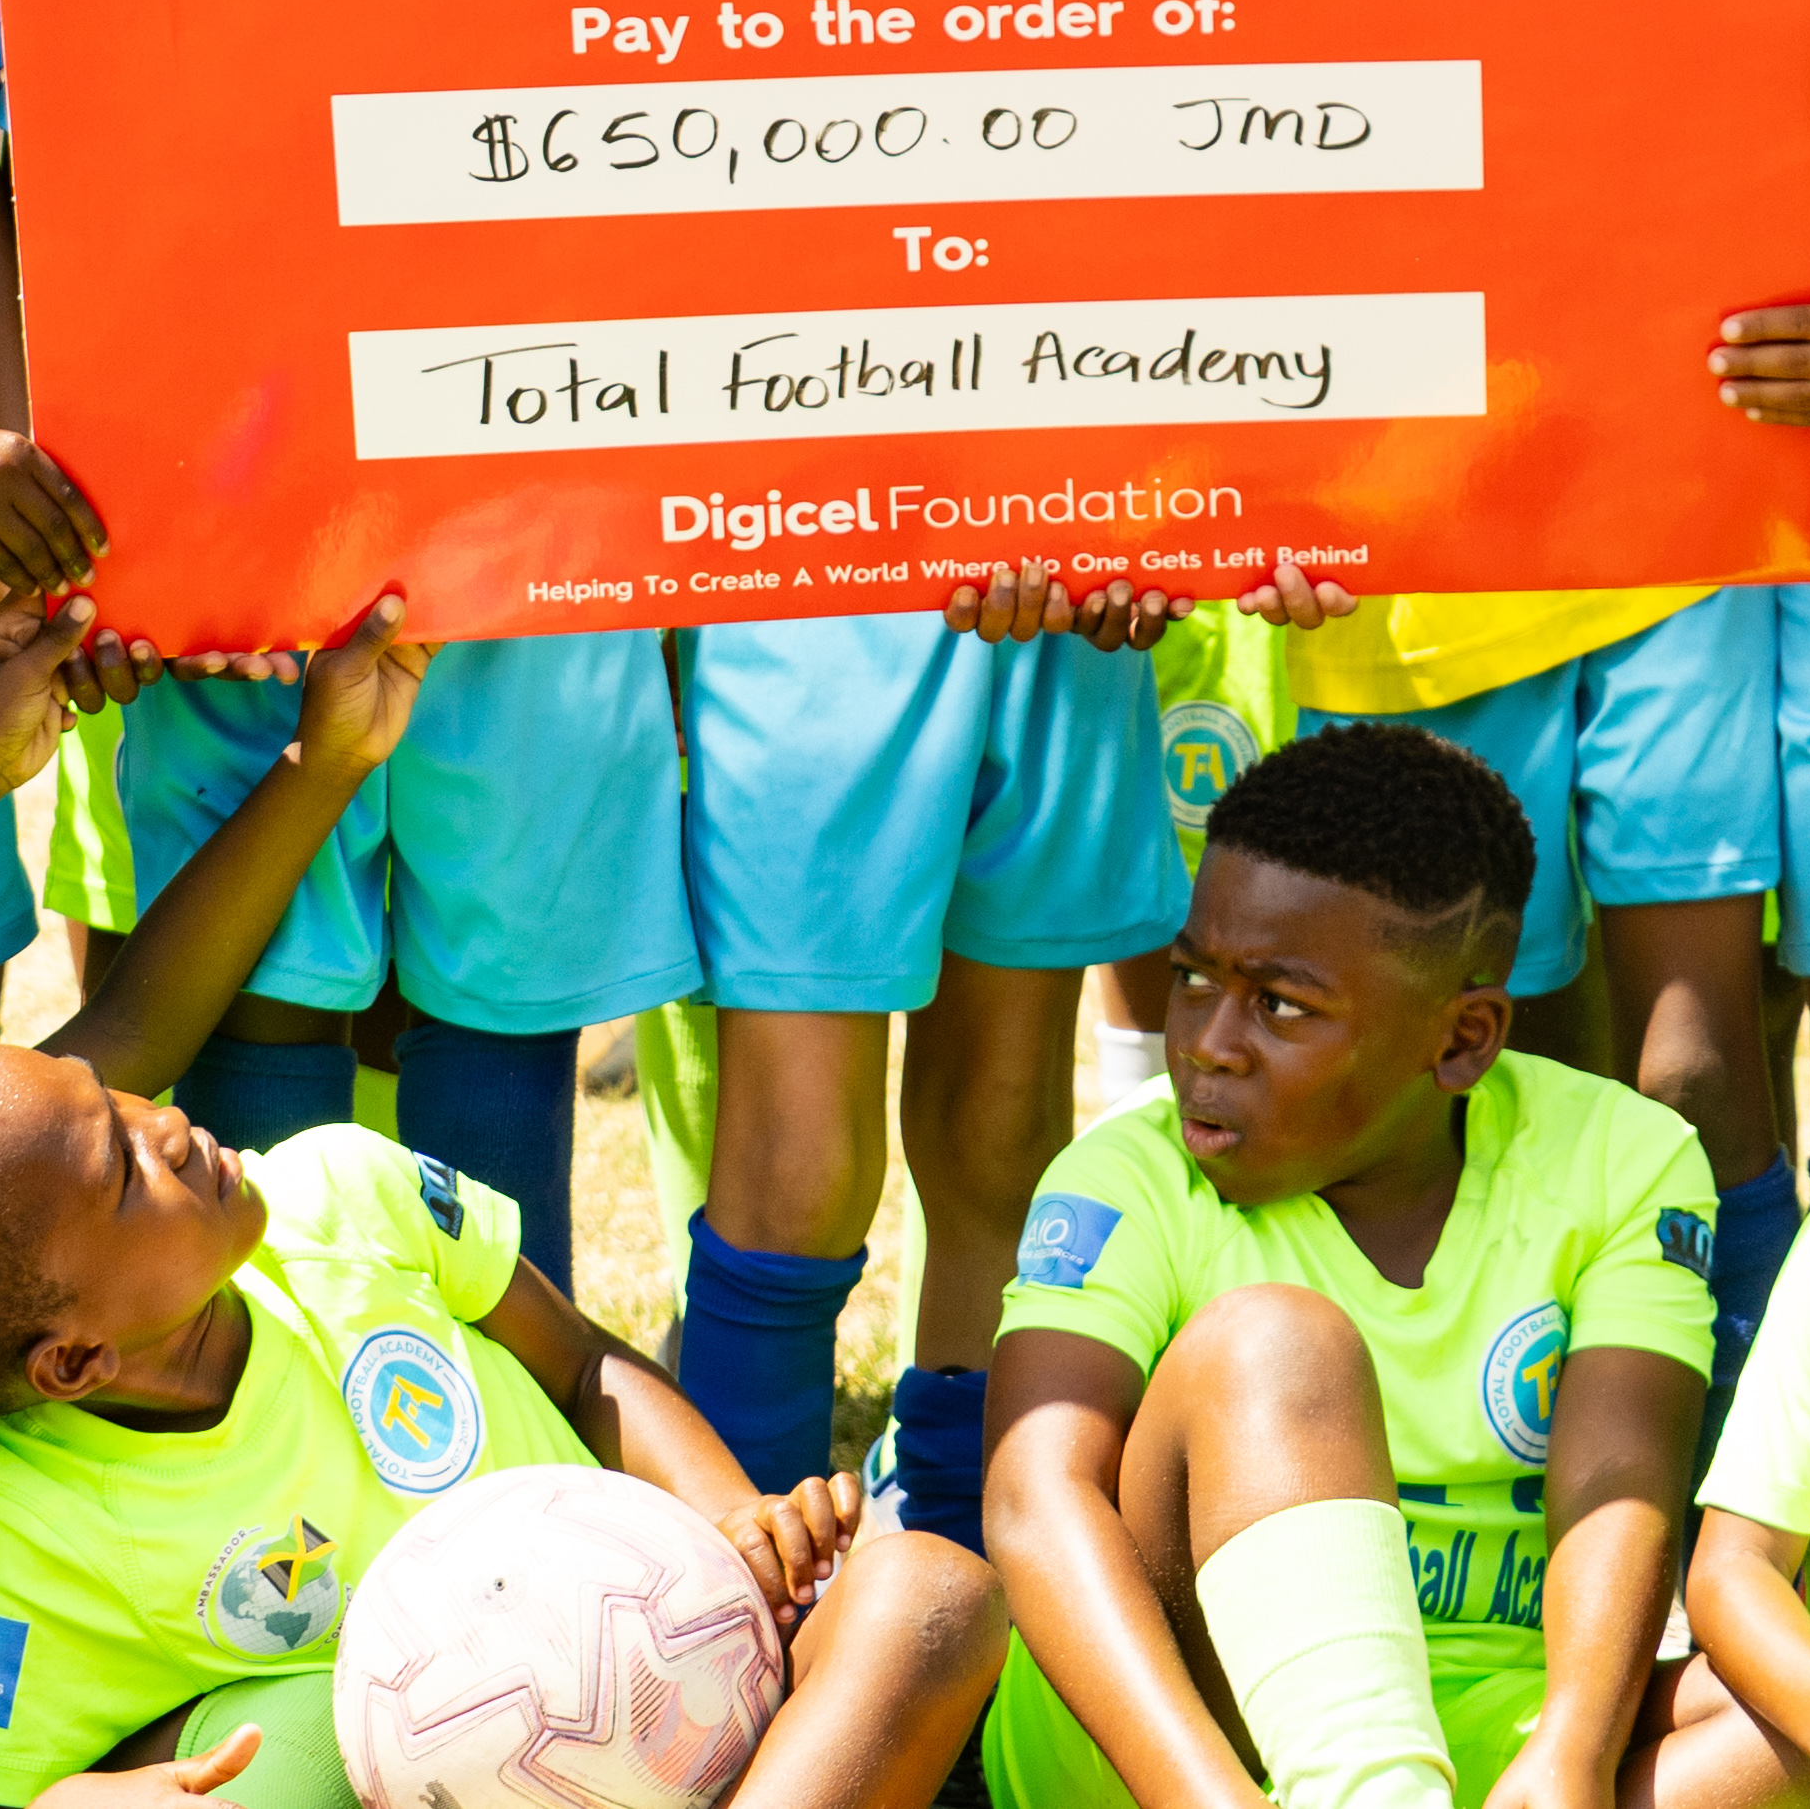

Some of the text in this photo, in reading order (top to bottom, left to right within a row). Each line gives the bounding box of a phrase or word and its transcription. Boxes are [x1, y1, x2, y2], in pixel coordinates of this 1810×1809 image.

[570, 6, 689, 64] Pay
[718, 1, 784, 48] to
[1173, 96, 1371, 153] JMD
[892, 225, 988, 273] To:
[422, 328, 1334, 425] Total Football Academy
[660, 477, 1243, 551] Digicel Foundation
[527, 578, 634, 605] Helping
[643, 574, 679, 596] To
[688, 568, 782, 592] Create
[792, 566, 814, 587] A
[824, 561, 909, 585] World
[920, 558, 1009, 580] Where
[1071, 552, 1129, 574] One
[1139, 548, 1203, 571] Gets
[1213, 546, 1266, 569] Left
[1276, 544, 1369, 567] Behind
[1021, 1217, 1070, 1249] AIO
[378, 1340, 444, 1372] ACADEMY
[1493, 1376, 1516, 1430] TOTAL
[366, 1439, 409, 1480] TOTAL
[196, 1530, 247, 1618] AMBASSADOR
